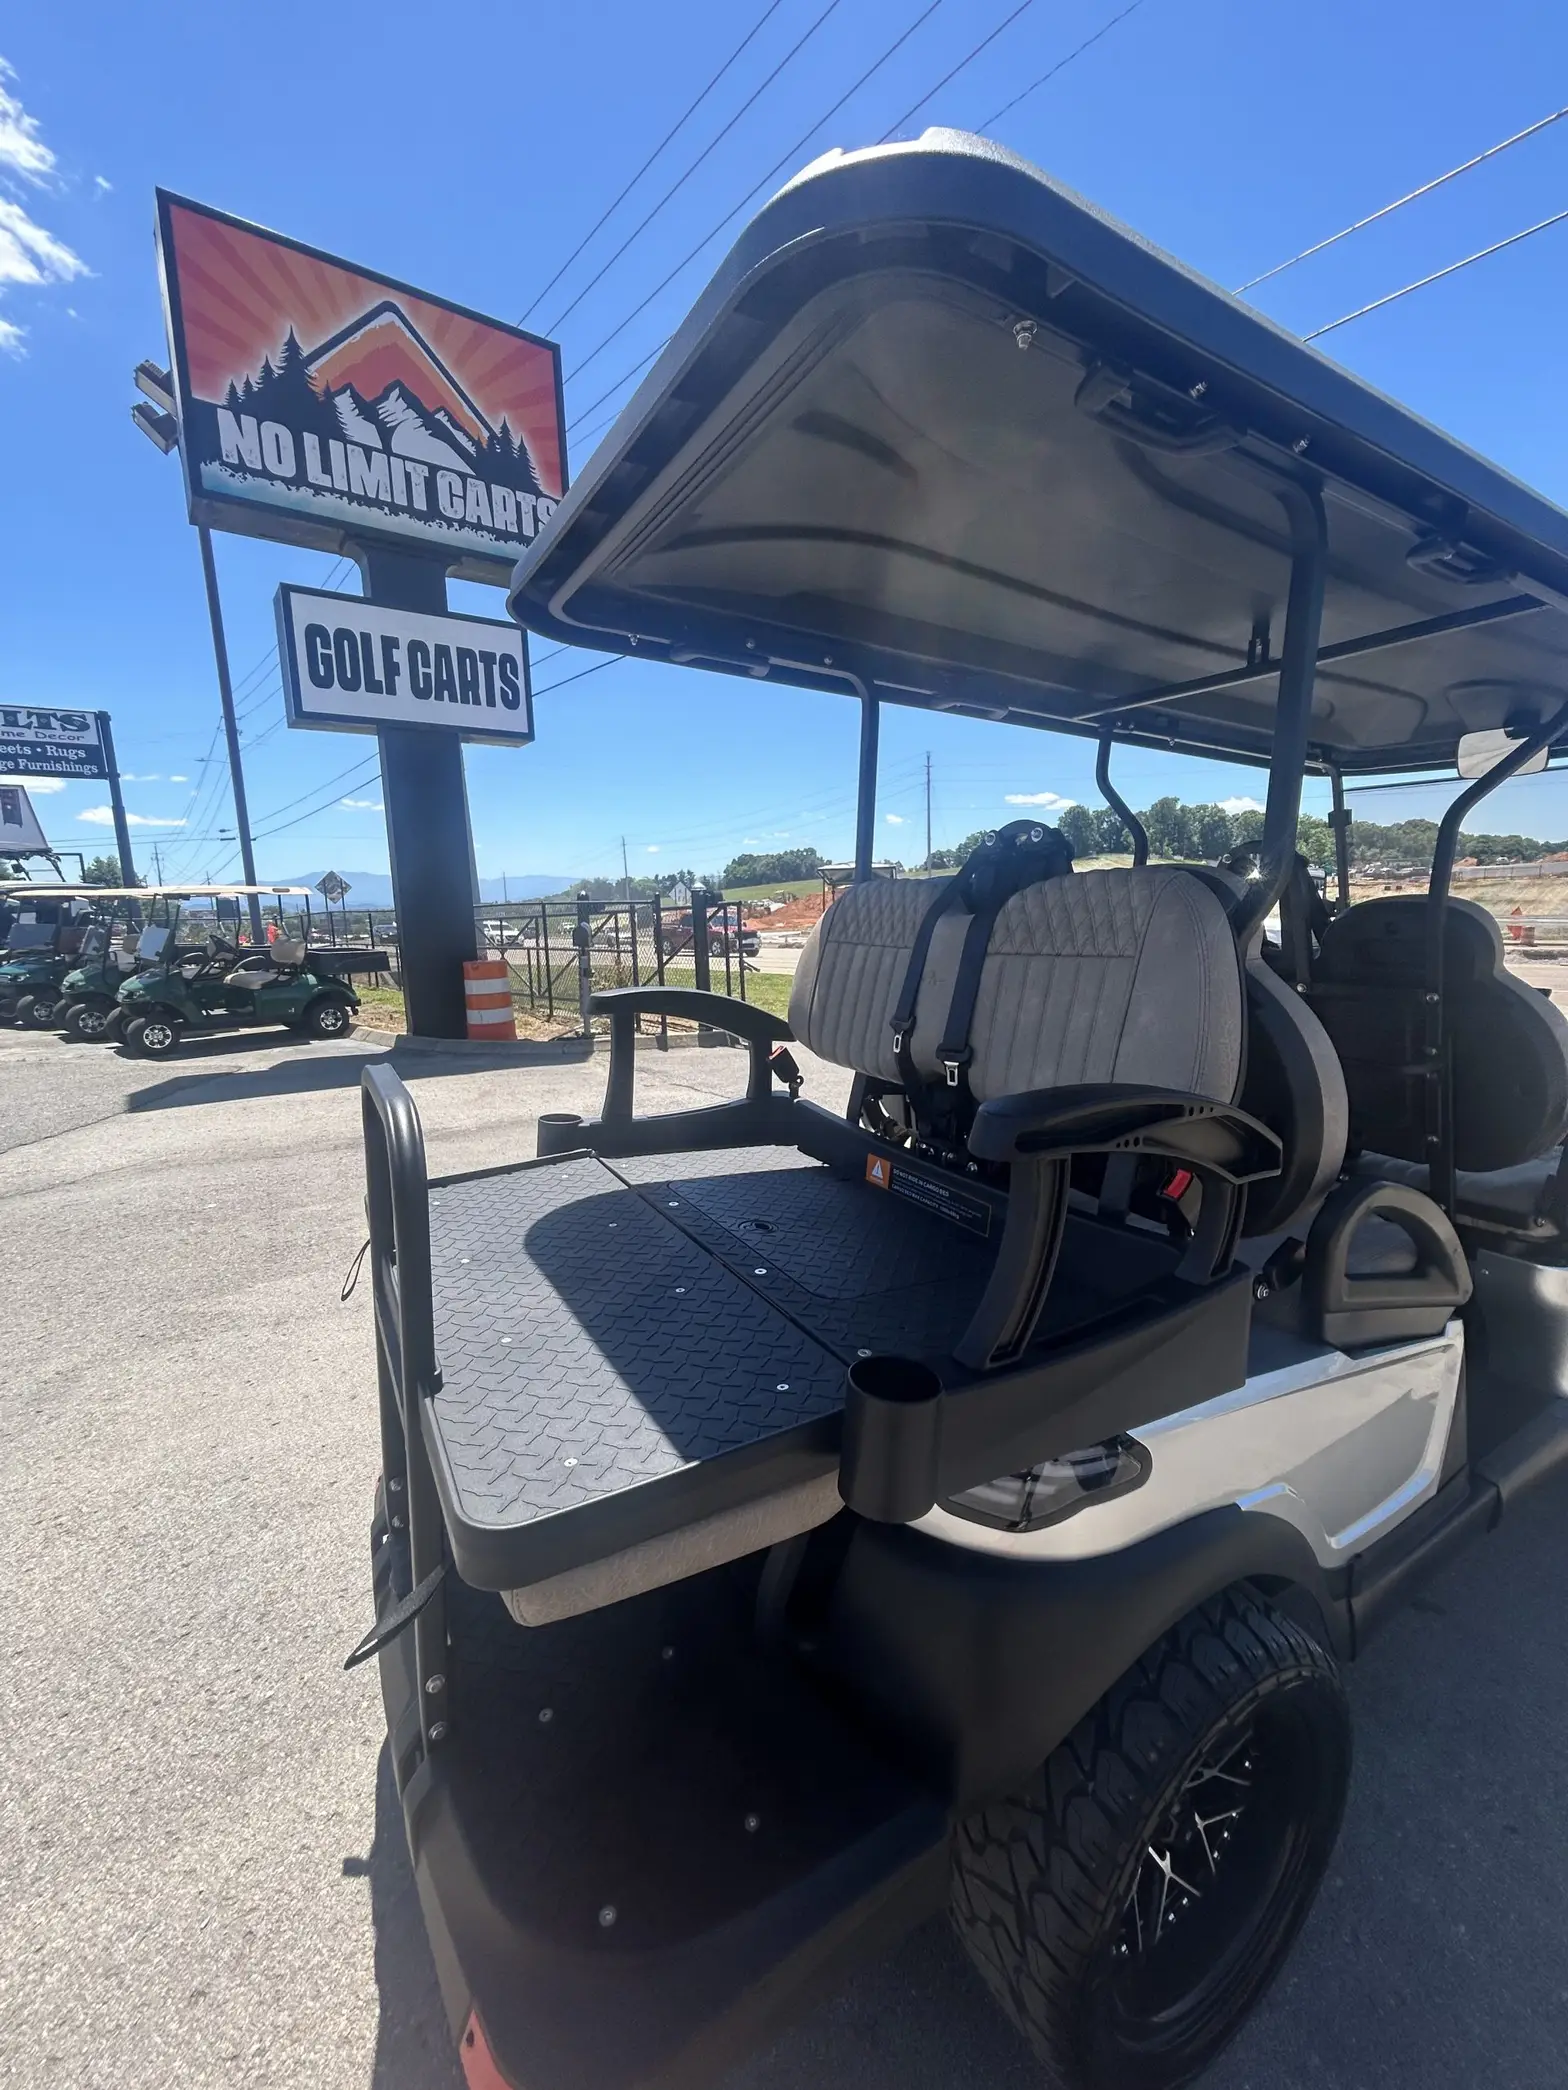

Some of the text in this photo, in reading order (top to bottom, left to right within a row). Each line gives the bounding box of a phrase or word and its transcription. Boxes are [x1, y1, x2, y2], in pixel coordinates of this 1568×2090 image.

[217, 407, 297, 478] NO
[303, 432, 429, 511] LIMIT
[304, 623, 520, 711] GOLF CARTS
[34, 731, 85, 741] Decor
[45, 745, 87, 760] Rugs
[17, 758, 98, 776] Furnishings
